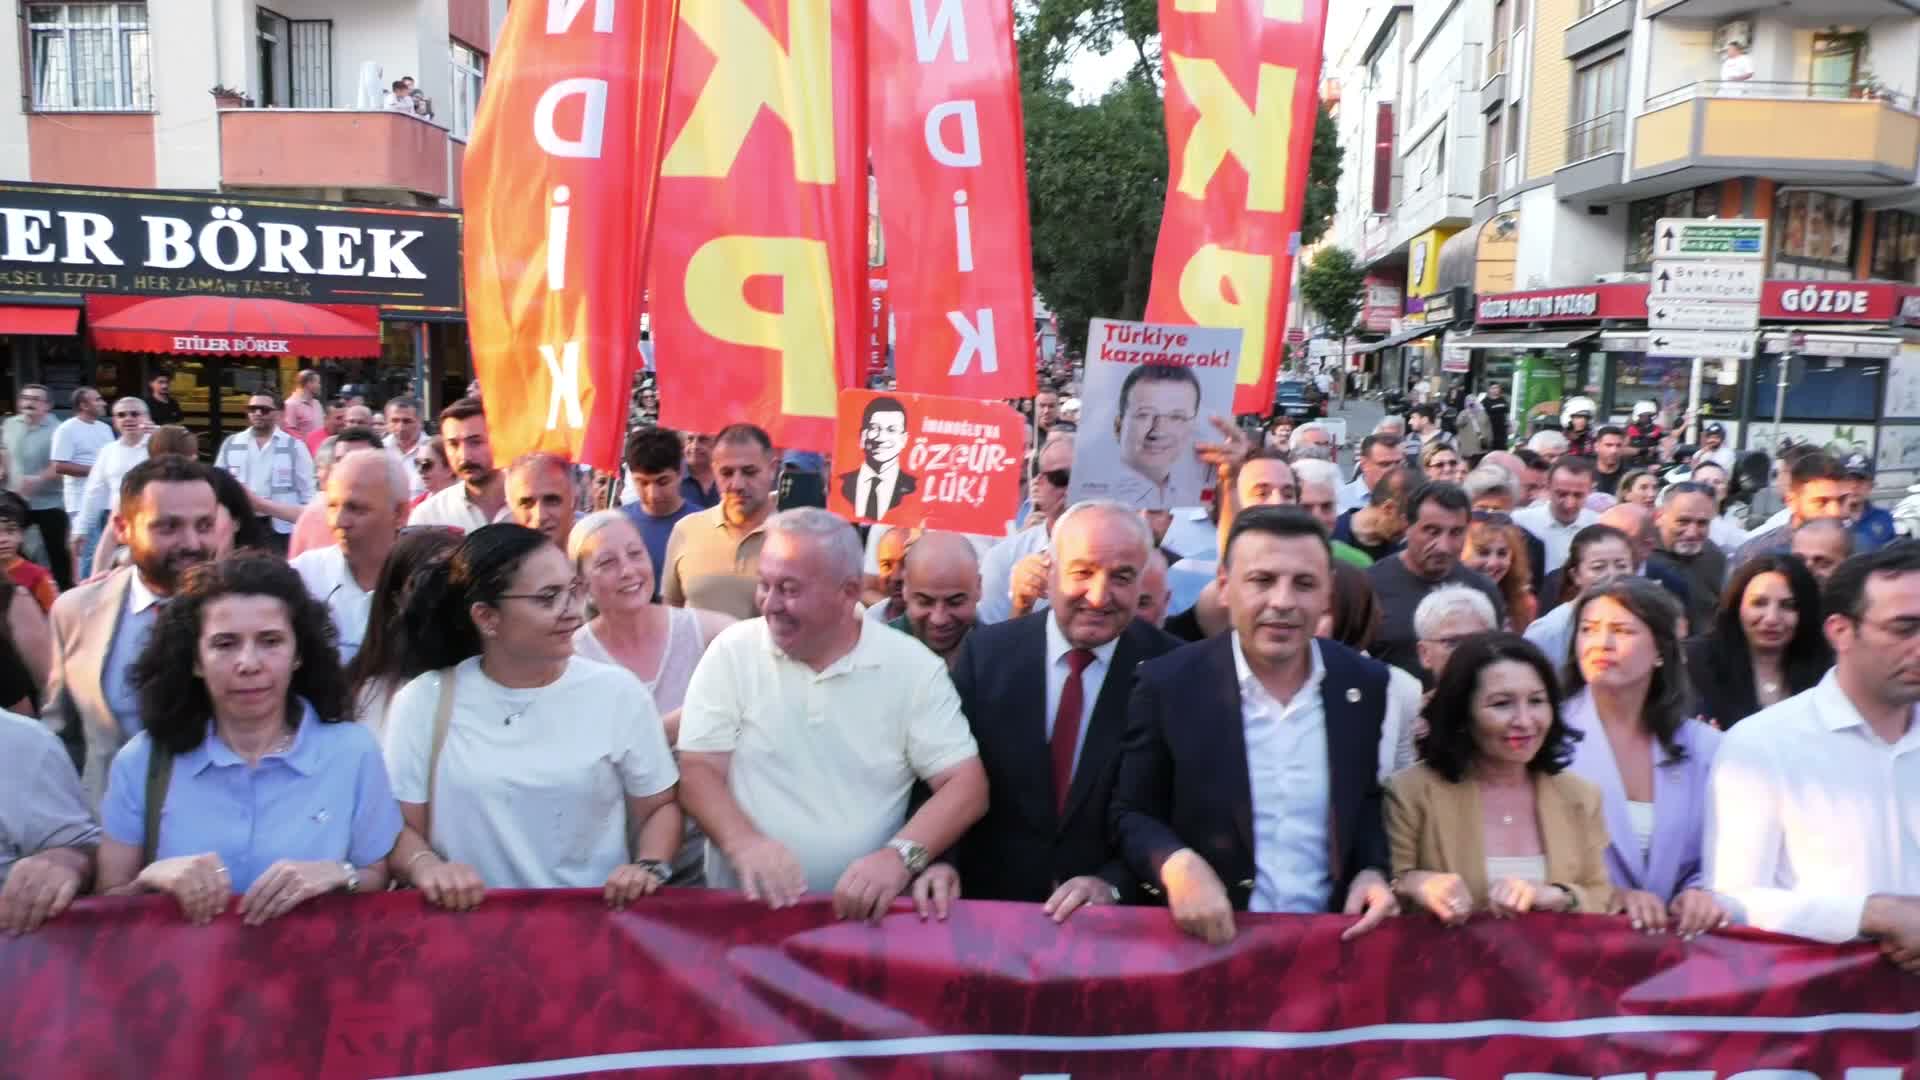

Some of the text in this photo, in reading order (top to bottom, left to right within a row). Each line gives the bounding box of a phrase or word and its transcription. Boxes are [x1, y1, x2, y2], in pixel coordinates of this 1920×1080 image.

[0, 206, 427, 279] ER BÖREK
[1781, 284, 1870, 313] GÖZDE
[173, 335, 290, 352] ETİLER BÖREK
[1104, 324, 1189, 350] Türkiye
[1100, 343, 1230, 368] kazanacak!
[908, 437, 1017, 473] ÖZGÜR-
[920, 472, 990, 507] LÜK!
